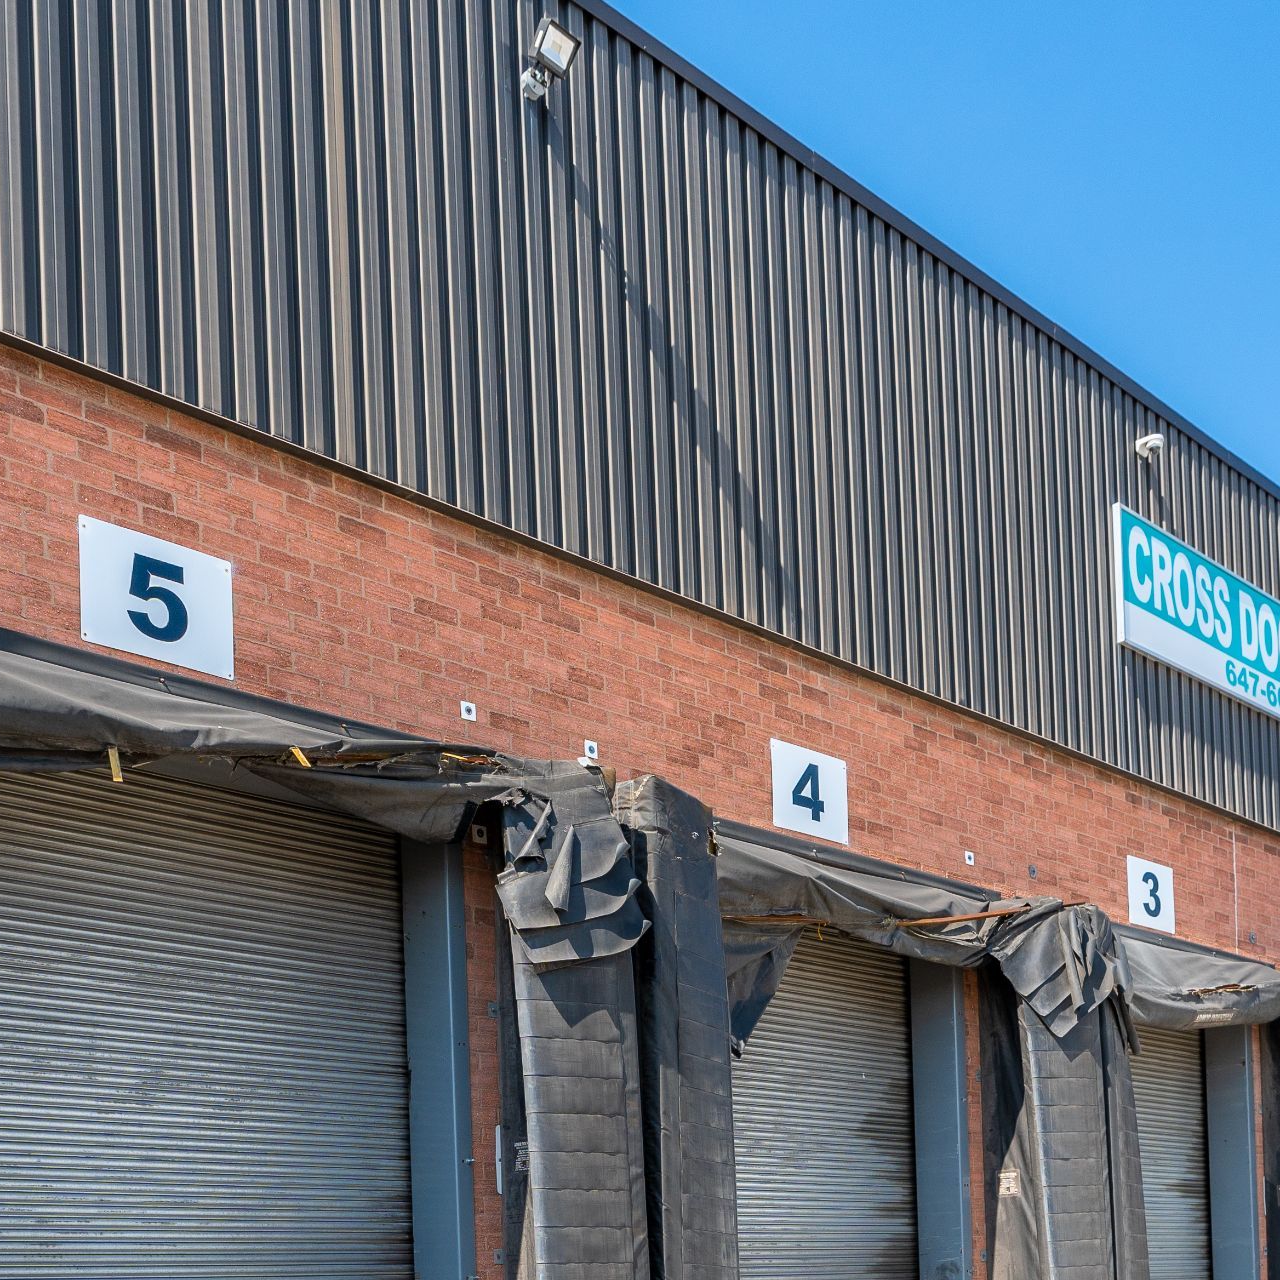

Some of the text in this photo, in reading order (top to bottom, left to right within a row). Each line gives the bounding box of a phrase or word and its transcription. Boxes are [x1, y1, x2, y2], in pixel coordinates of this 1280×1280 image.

[127, 553, 188, 642] 5
[1128, 526, 1232, 648] CROSS
[792, 763, 824, 822] 4
[1142, 872, 1161, 917] 3
